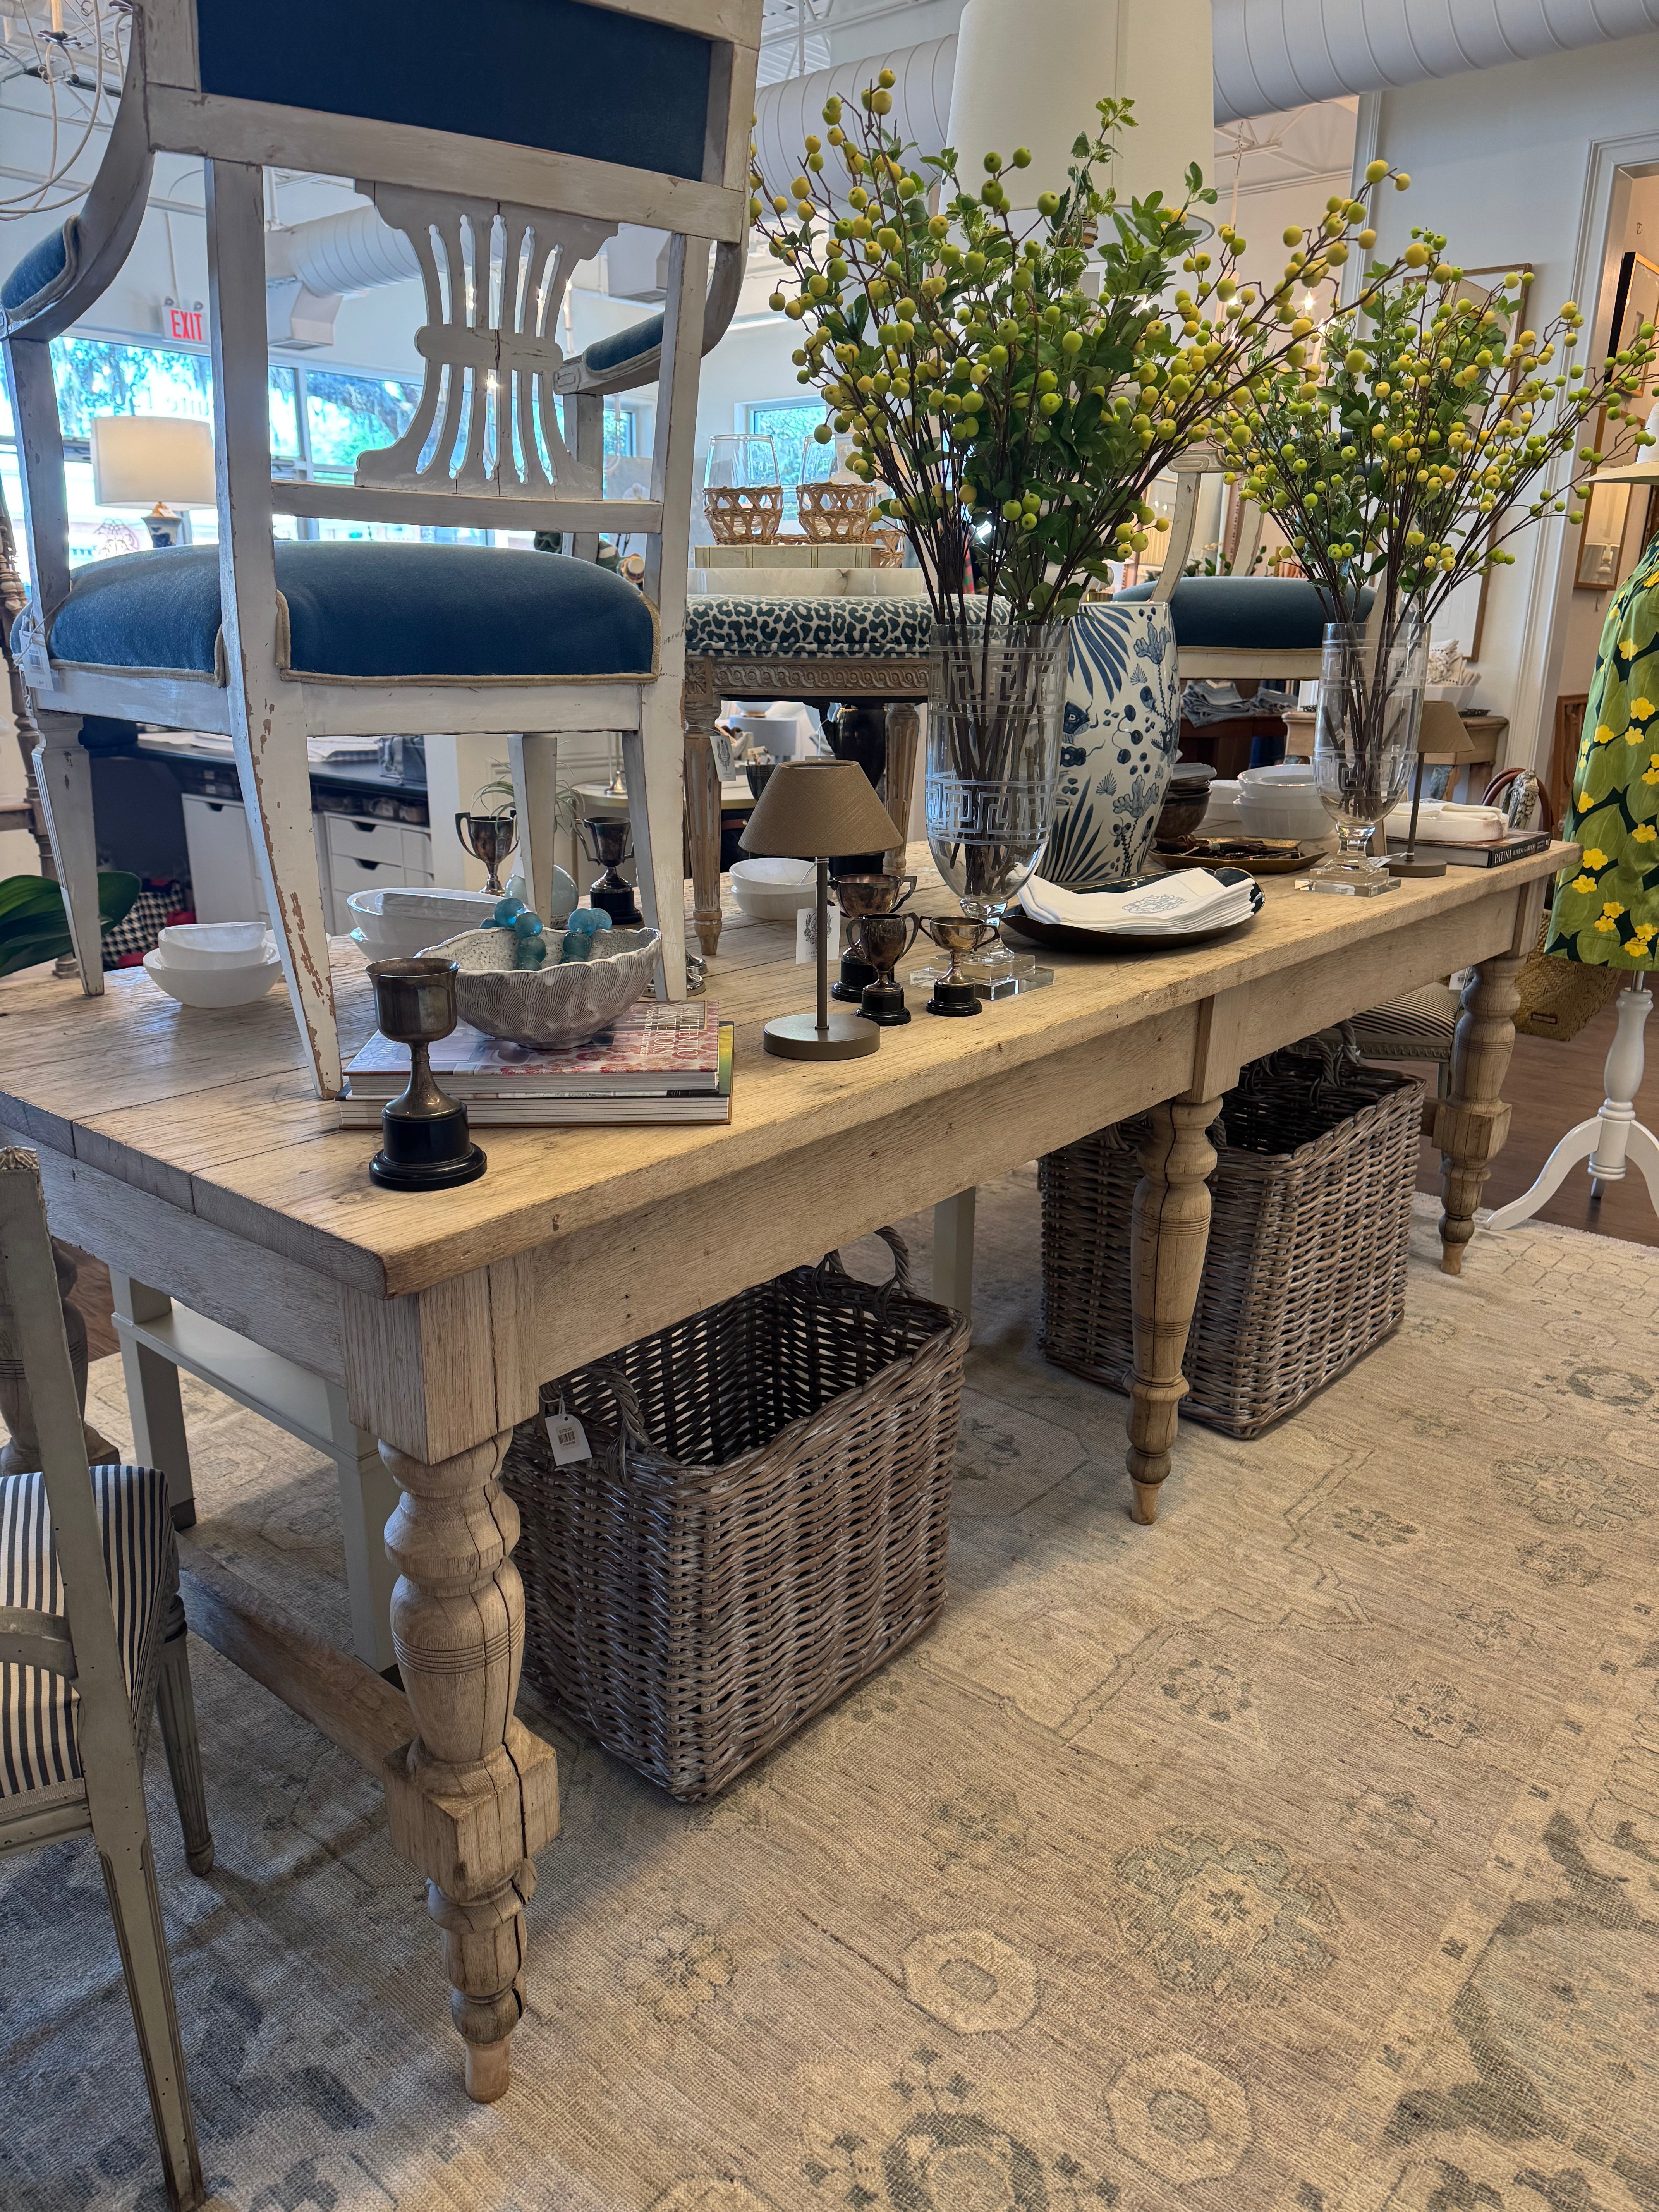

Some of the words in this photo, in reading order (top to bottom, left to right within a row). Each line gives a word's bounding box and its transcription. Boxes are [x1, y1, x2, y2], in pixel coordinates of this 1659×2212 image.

[170, 309, 202, 341] EXIT
[1494, 849, 1512, 863] PATINA
[645, 1009, 655, 1021] ROOMS
[642, 1031, 651, 1040] TELL
[653, 1012, 677, 1054] INTERIORS
[677, 1011, 699, 1056] AUTHENTIC
[640, 1041, 649, 1056] STORIES
